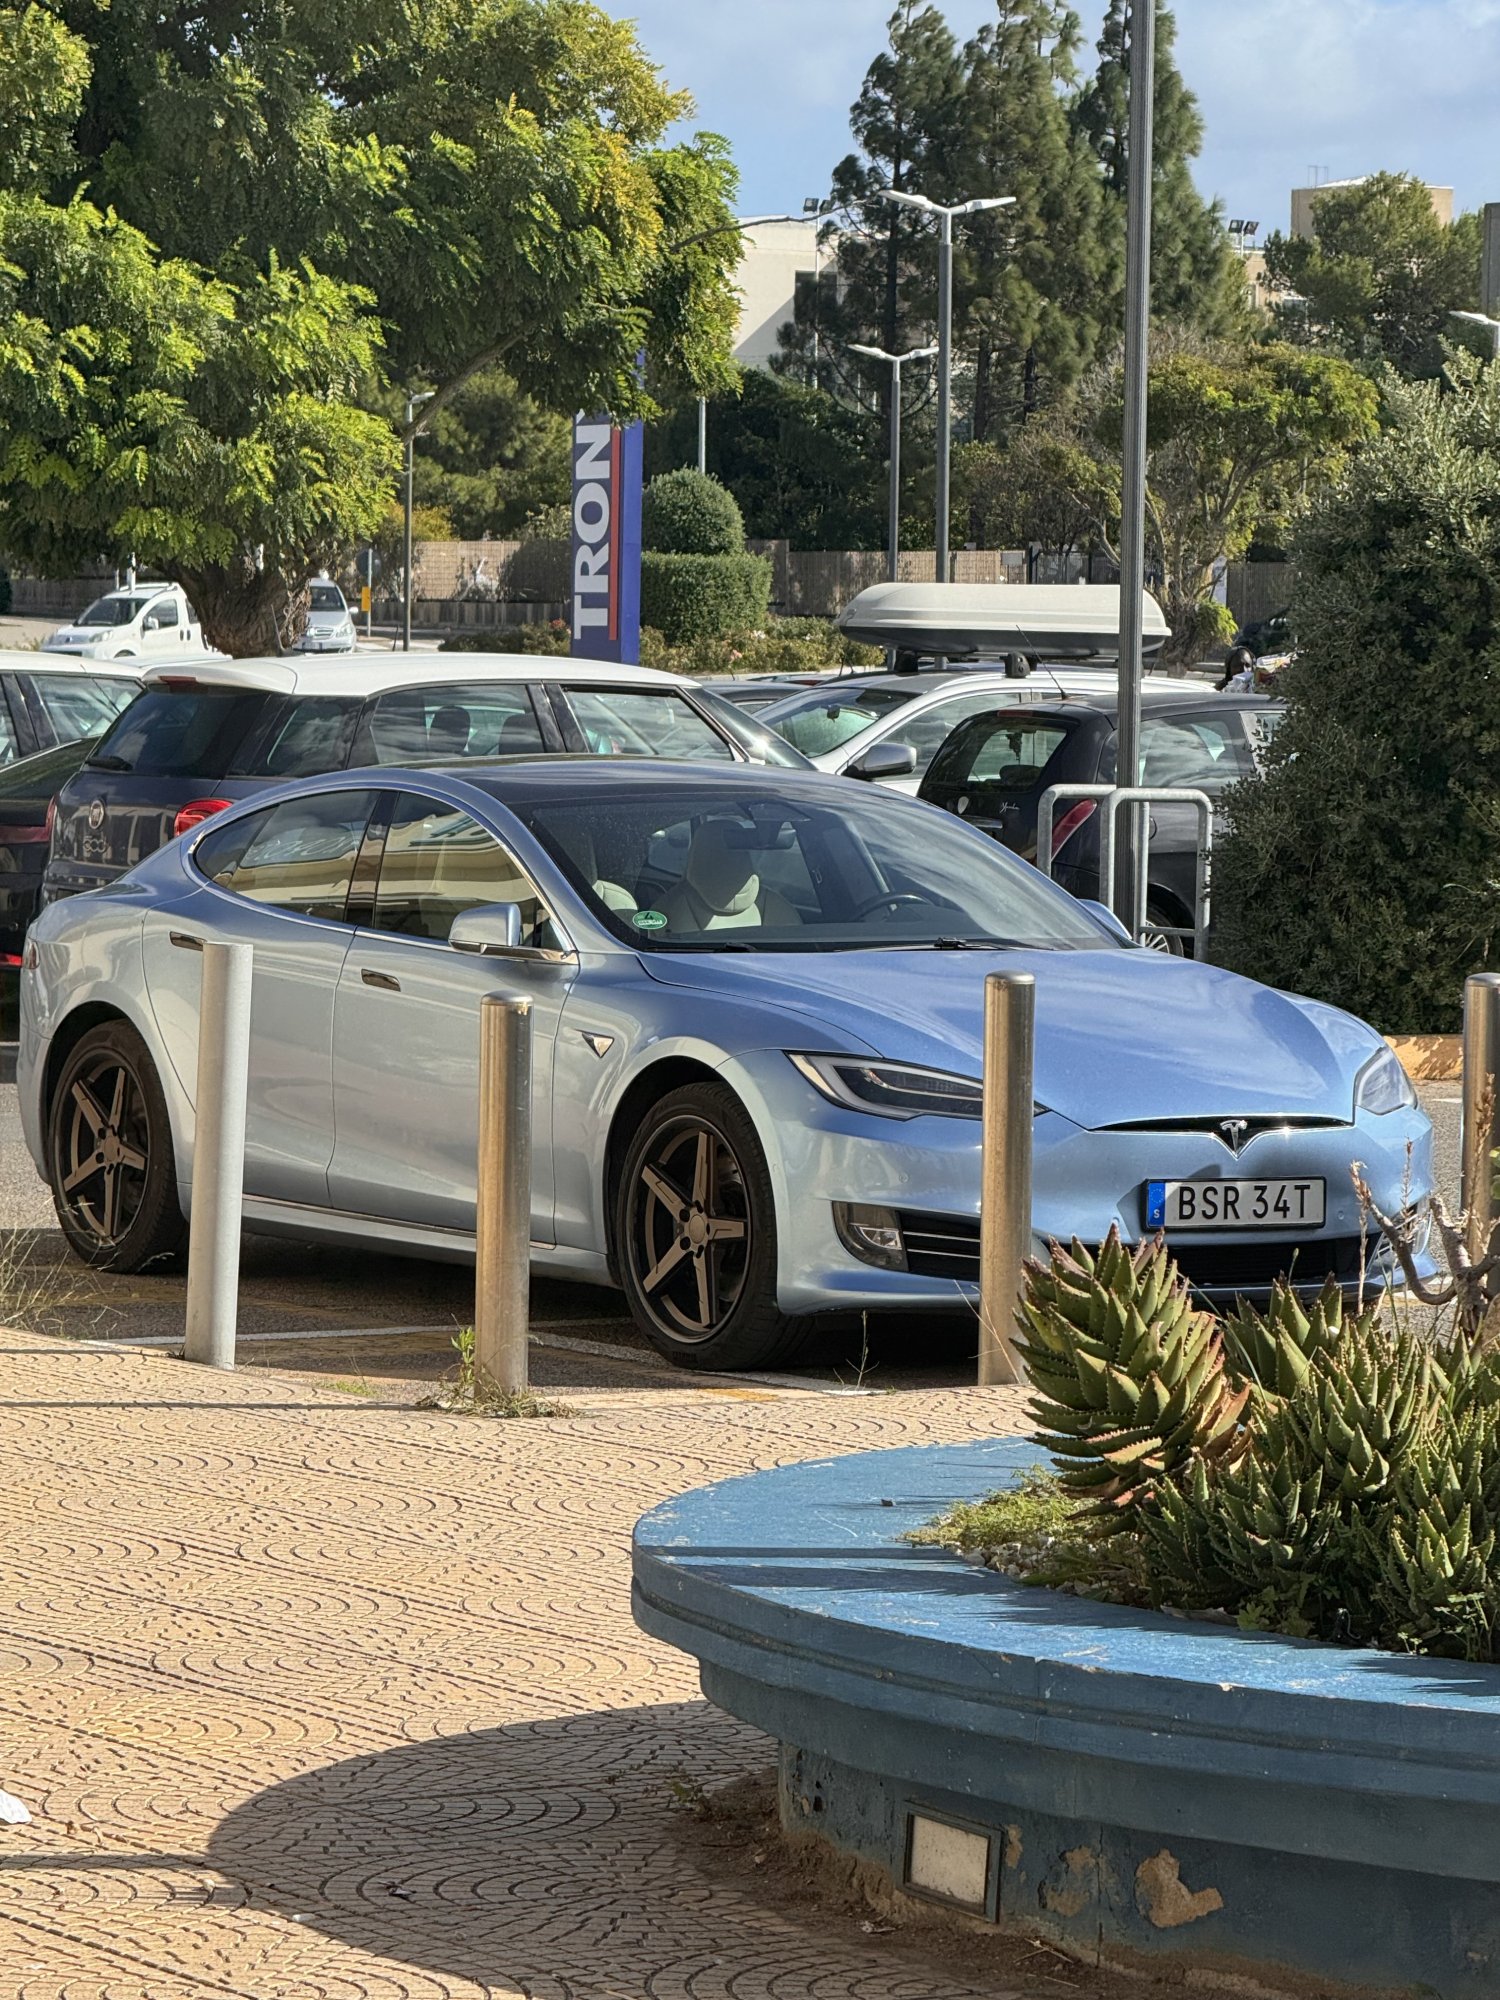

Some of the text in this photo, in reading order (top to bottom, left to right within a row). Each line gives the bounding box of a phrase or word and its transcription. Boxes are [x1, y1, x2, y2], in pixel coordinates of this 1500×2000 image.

[574, 408, 611, 640] TRON
[1153, 1209, 1160, 1218] S
[1179, 1185, 1311, 1220] BSR 34T
